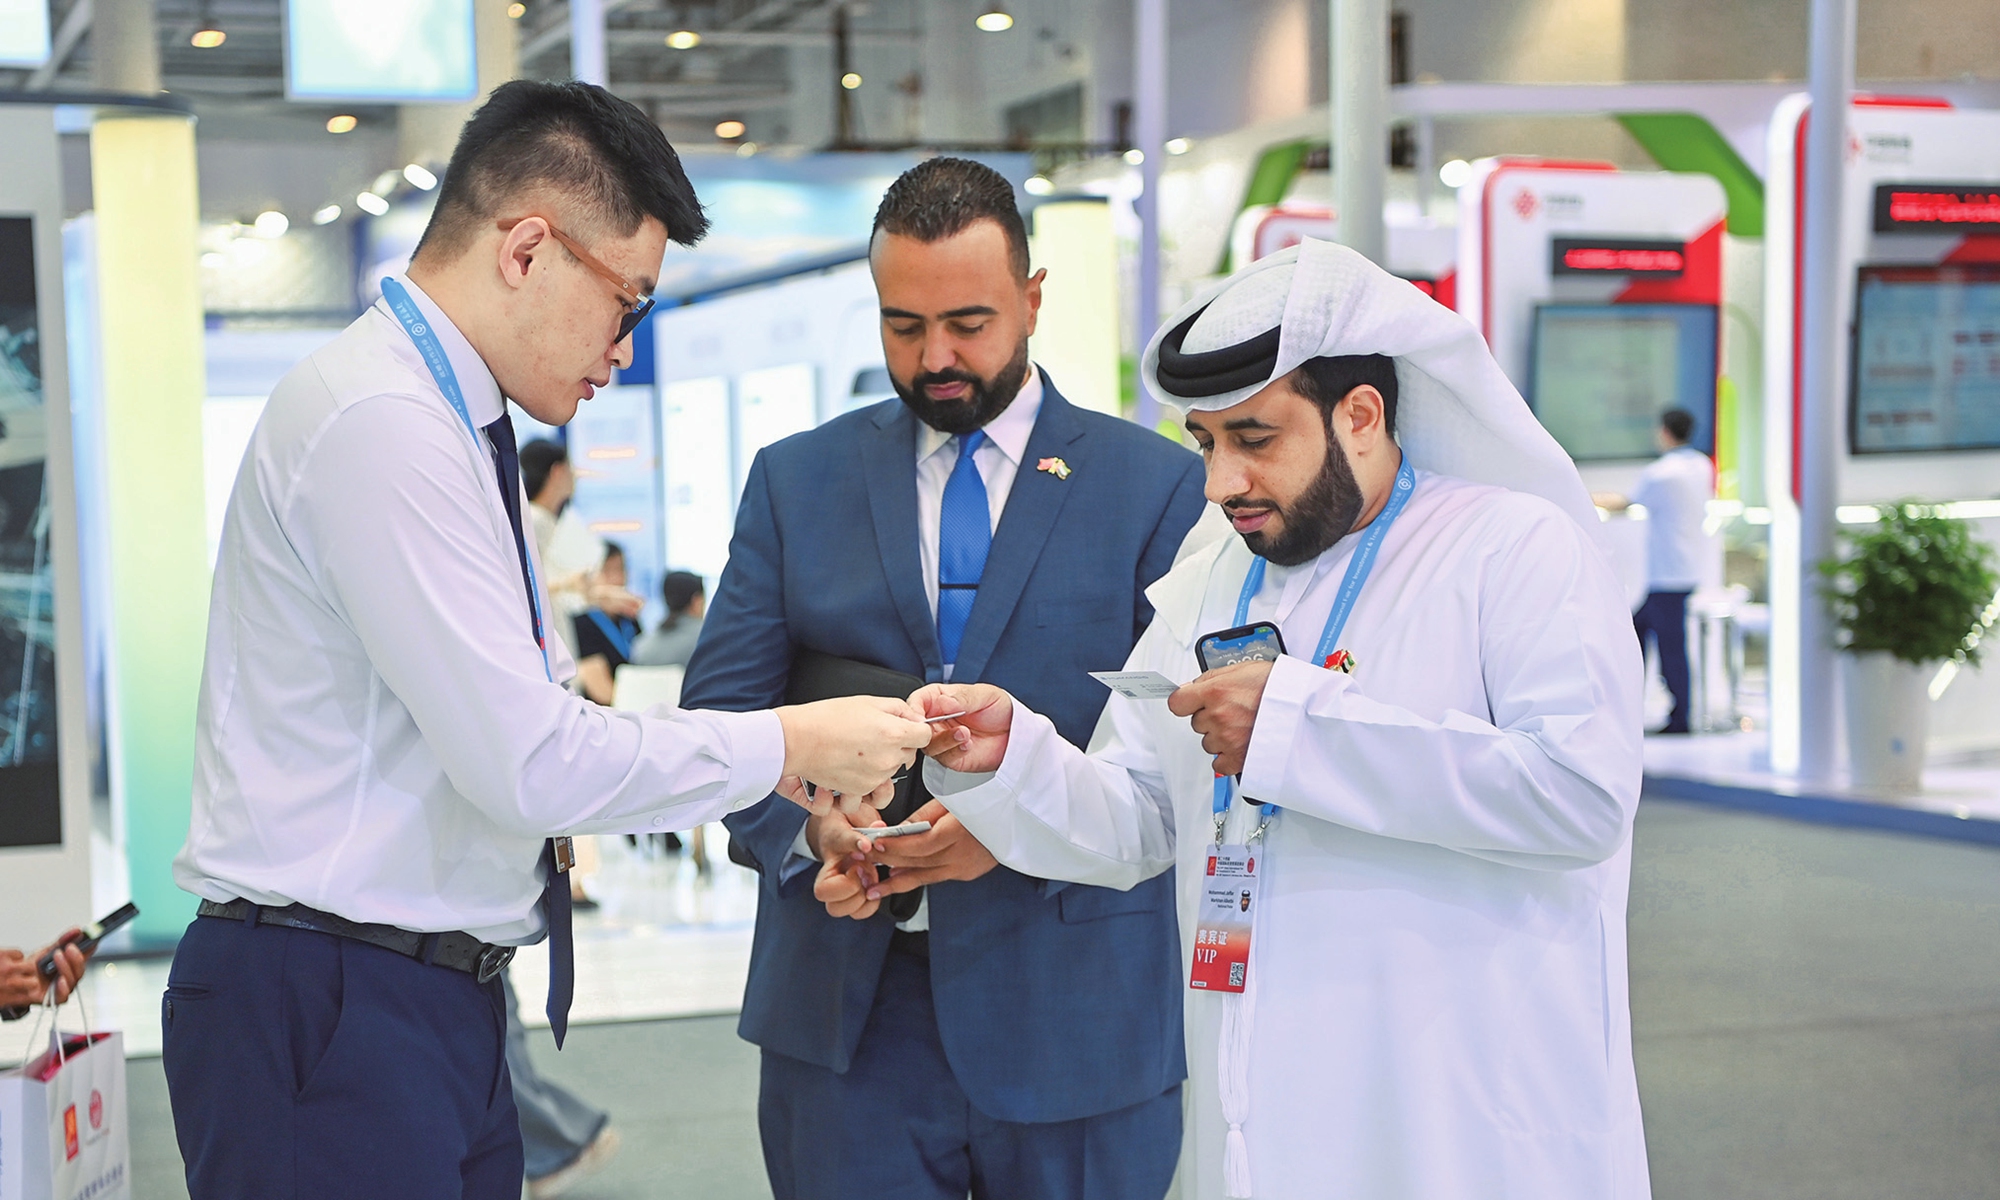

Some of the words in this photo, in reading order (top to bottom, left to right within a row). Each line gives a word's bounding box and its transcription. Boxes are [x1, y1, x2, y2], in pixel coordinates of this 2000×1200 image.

[1318, 638, 1330, 657] China
[1326, 601, 1347, 639] International
[1352, 546, 1371, 580] Investment
[1369, 524, 1381, 541] Trade
[1198, 929, 1228, 945] 贵宾证
[1197, 948, 1217, 964] VIP
